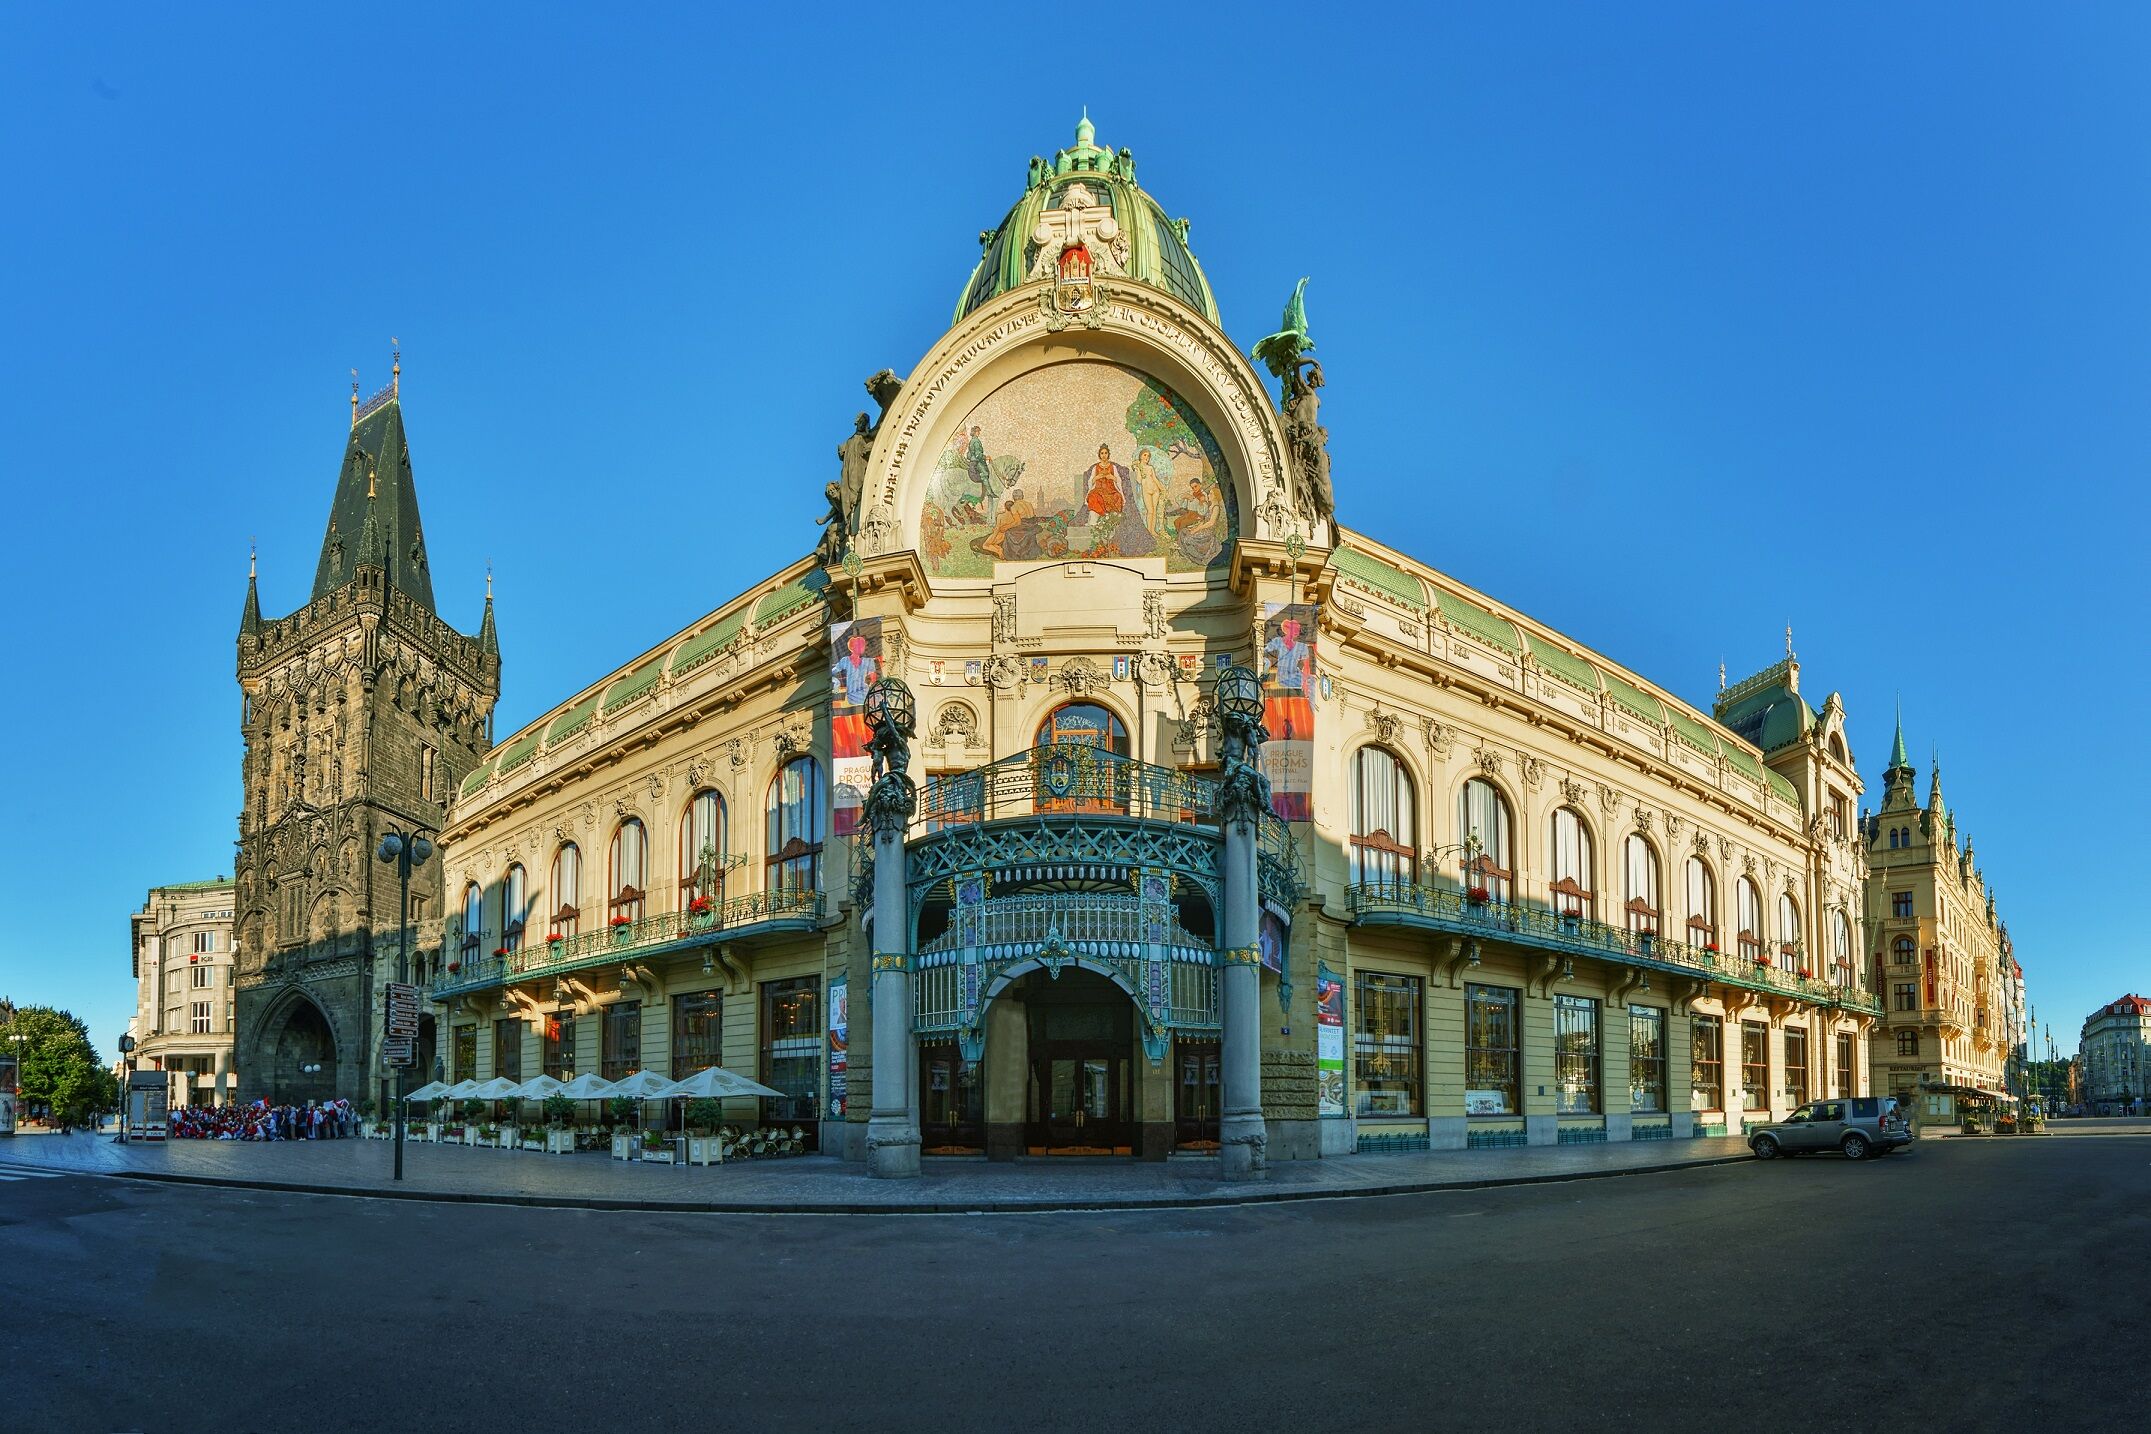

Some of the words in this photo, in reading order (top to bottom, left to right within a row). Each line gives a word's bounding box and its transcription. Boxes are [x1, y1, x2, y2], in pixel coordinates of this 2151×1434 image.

[1270, 750, 1303, 758] PRAGUE
[1266, 758, 1308, 768] PROMS
[844, 766, 871, 774] PRAGU
[839, 774, 872, 785] PROM
